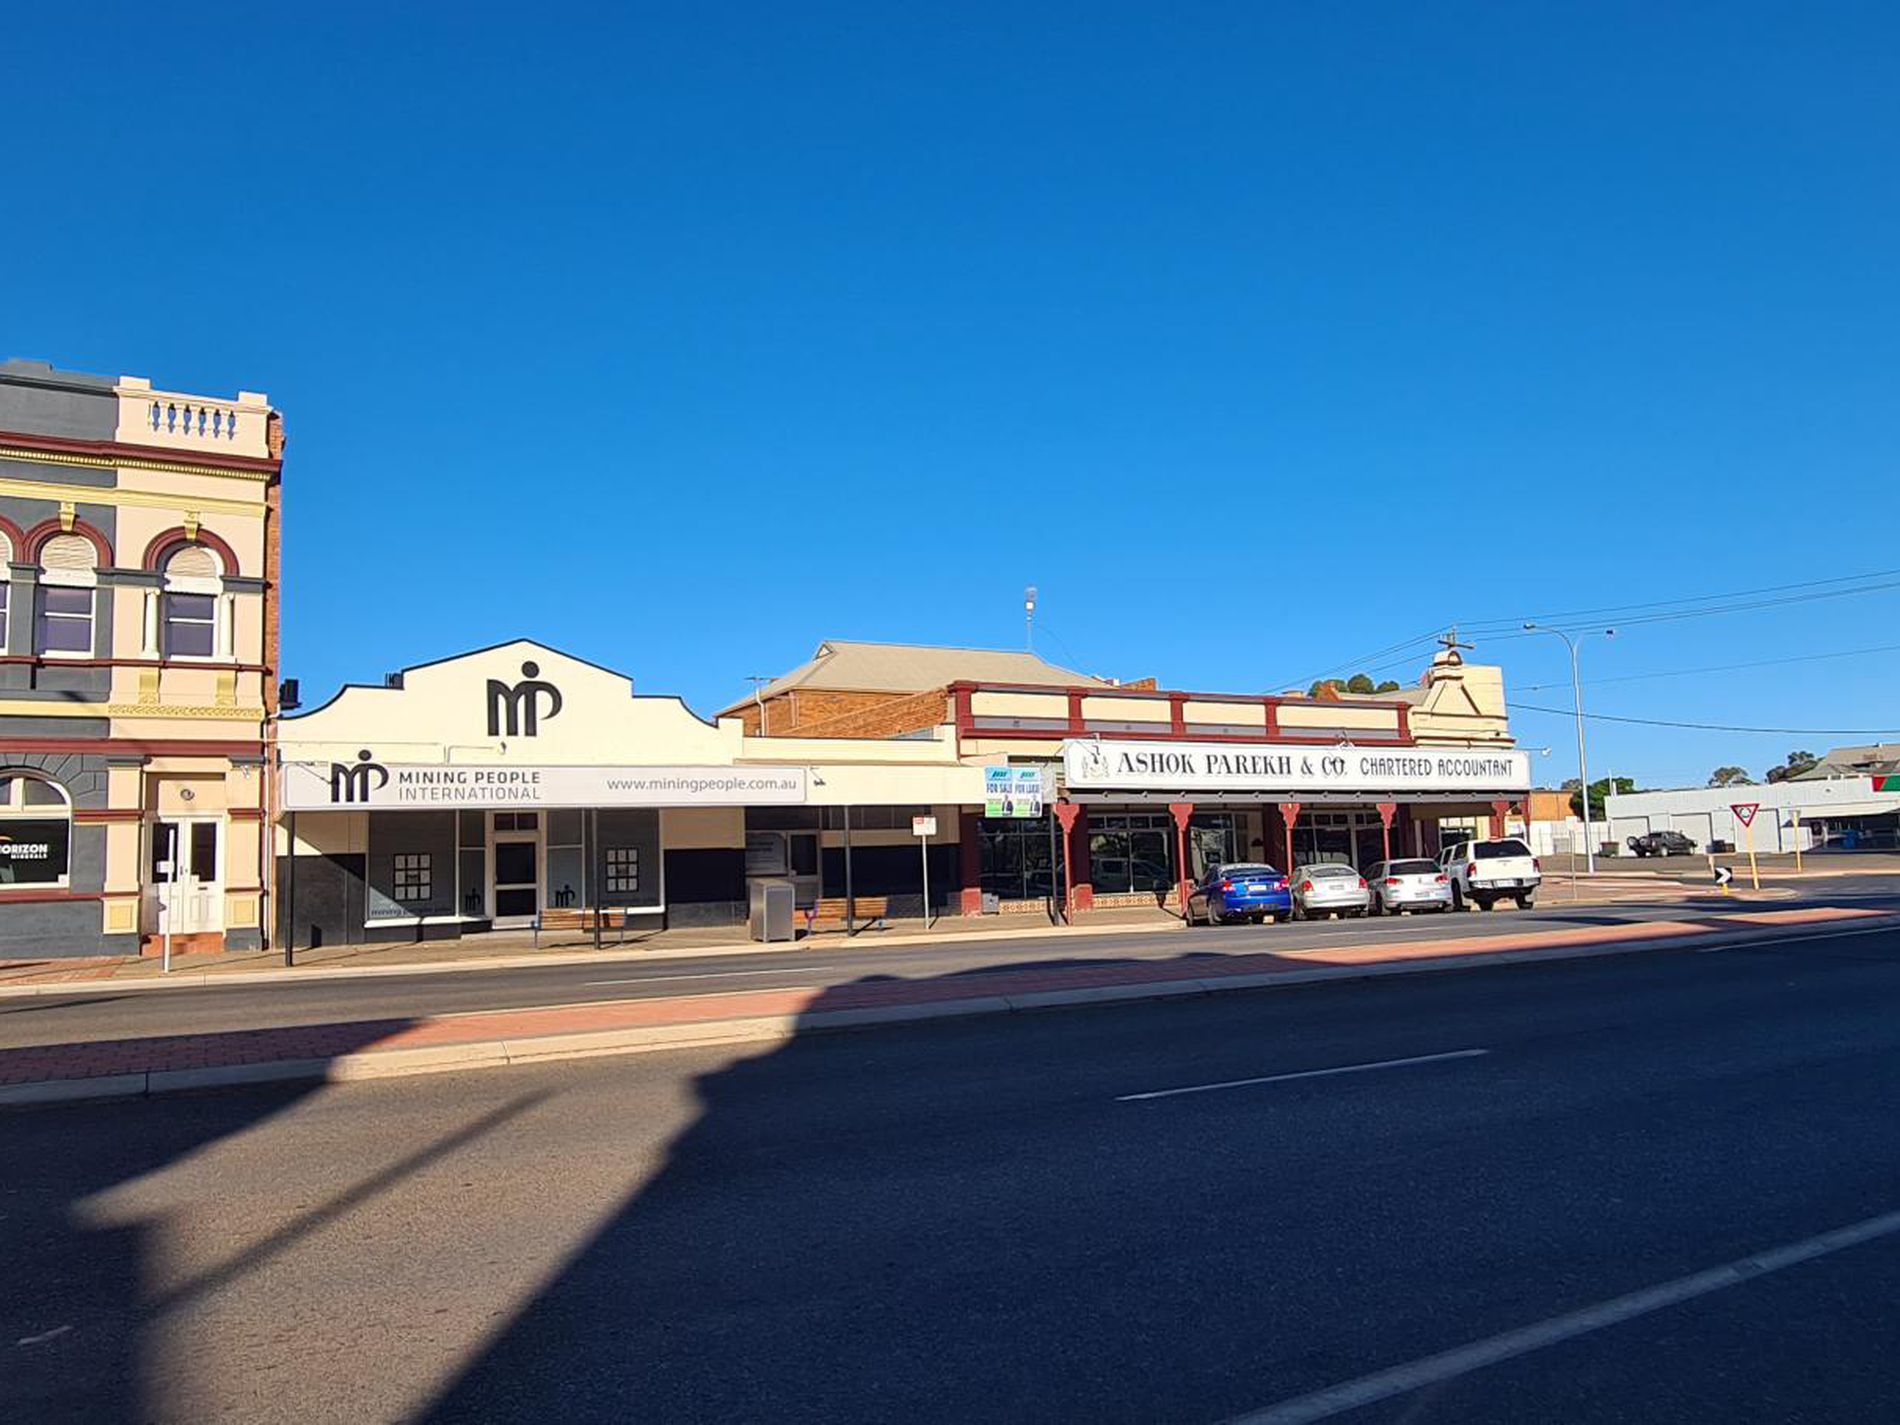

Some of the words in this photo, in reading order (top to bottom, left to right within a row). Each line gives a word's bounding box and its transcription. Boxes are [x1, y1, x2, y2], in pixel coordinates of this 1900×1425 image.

[1117, 752, 1196, 774] ASHOK
[1205, 753, 1292, 775] PAREKH
[1300, 756, 1314, 776] &
[1360, 757, 1432, 776] CHARTERED
[1438, 758, 1513, 777] ACCOUNTANT
[399, 771, 467, 784] MINING
[475, 771, 540, 784] PEOPLE
[607, 777, 797, 792] www.miningpeople.com.au
[399, 787, 541, 800] INTERNATIONAL
[0, 843, 48, 854] ORIZON
